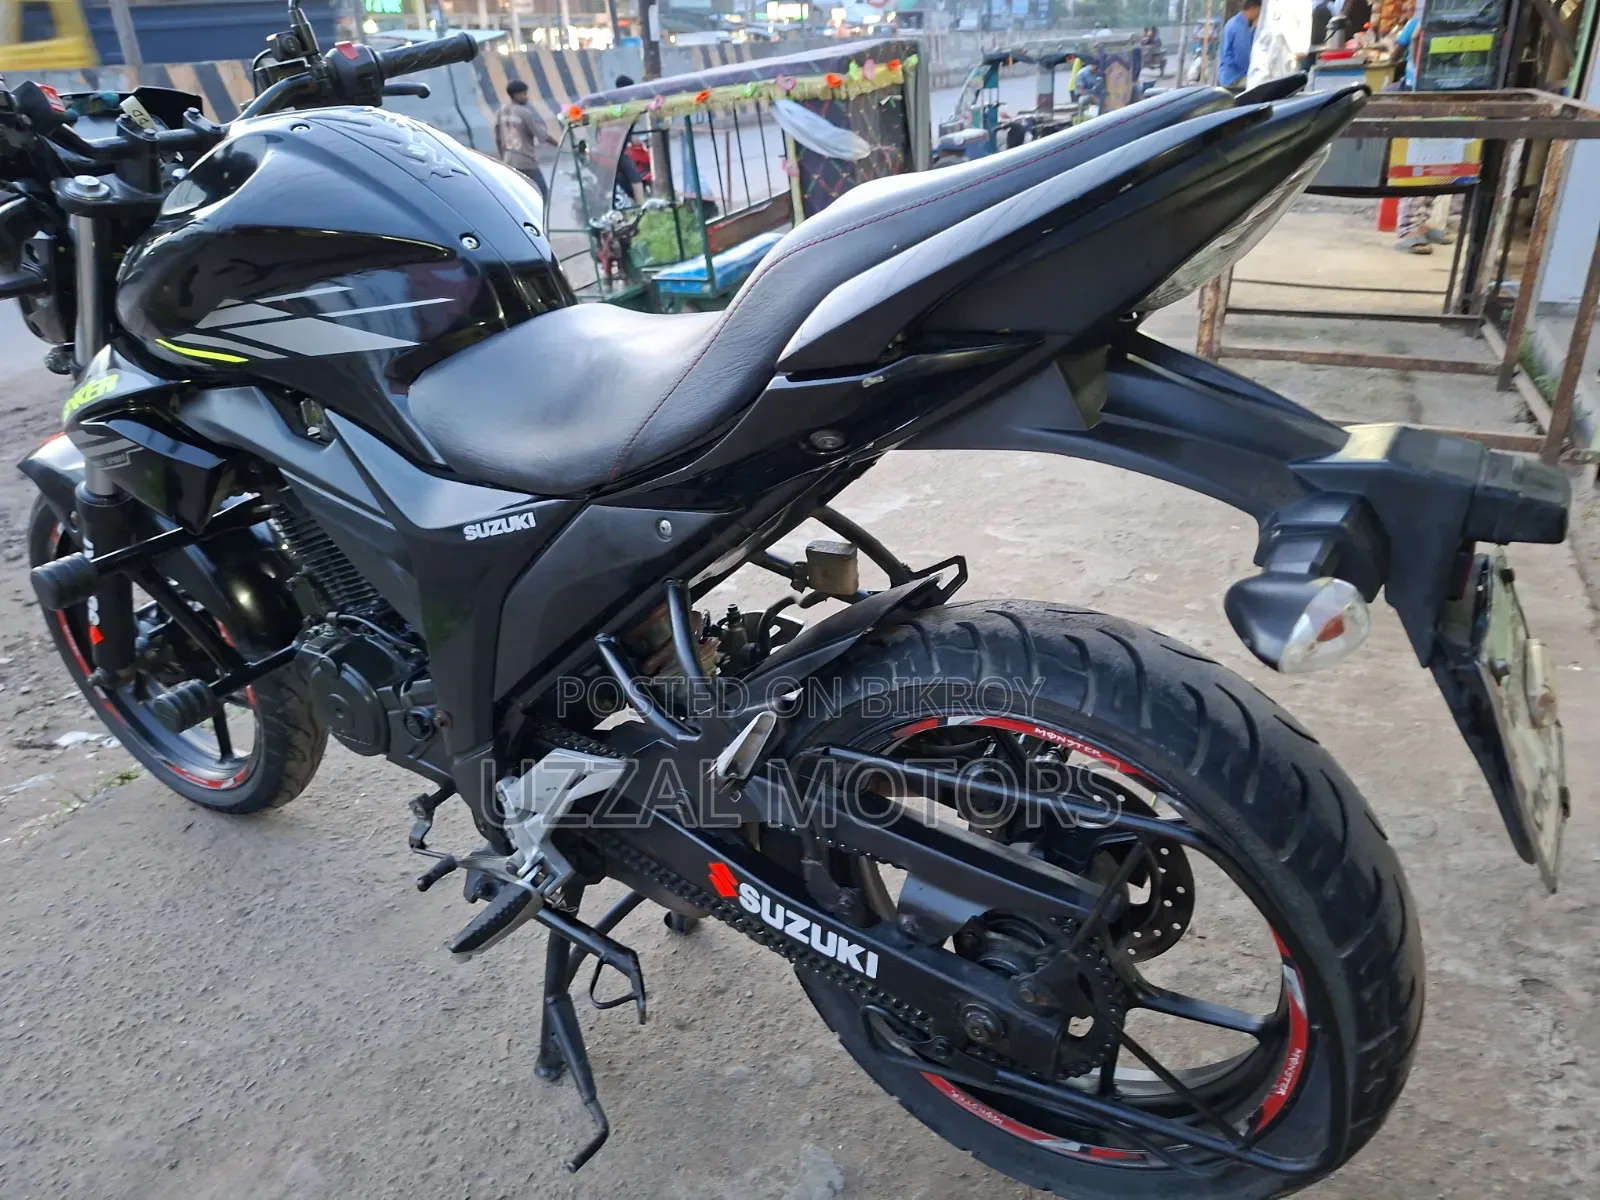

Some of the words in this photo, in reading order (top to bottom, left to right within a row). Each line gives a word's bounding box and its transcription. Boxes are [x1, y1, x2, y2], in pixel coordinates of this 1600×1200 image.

[463, 512, 537, 541] SUZUKI
[1034, 727, 1103, 758] MONSTER
[738, 882, 879, 979] SUZUKI
